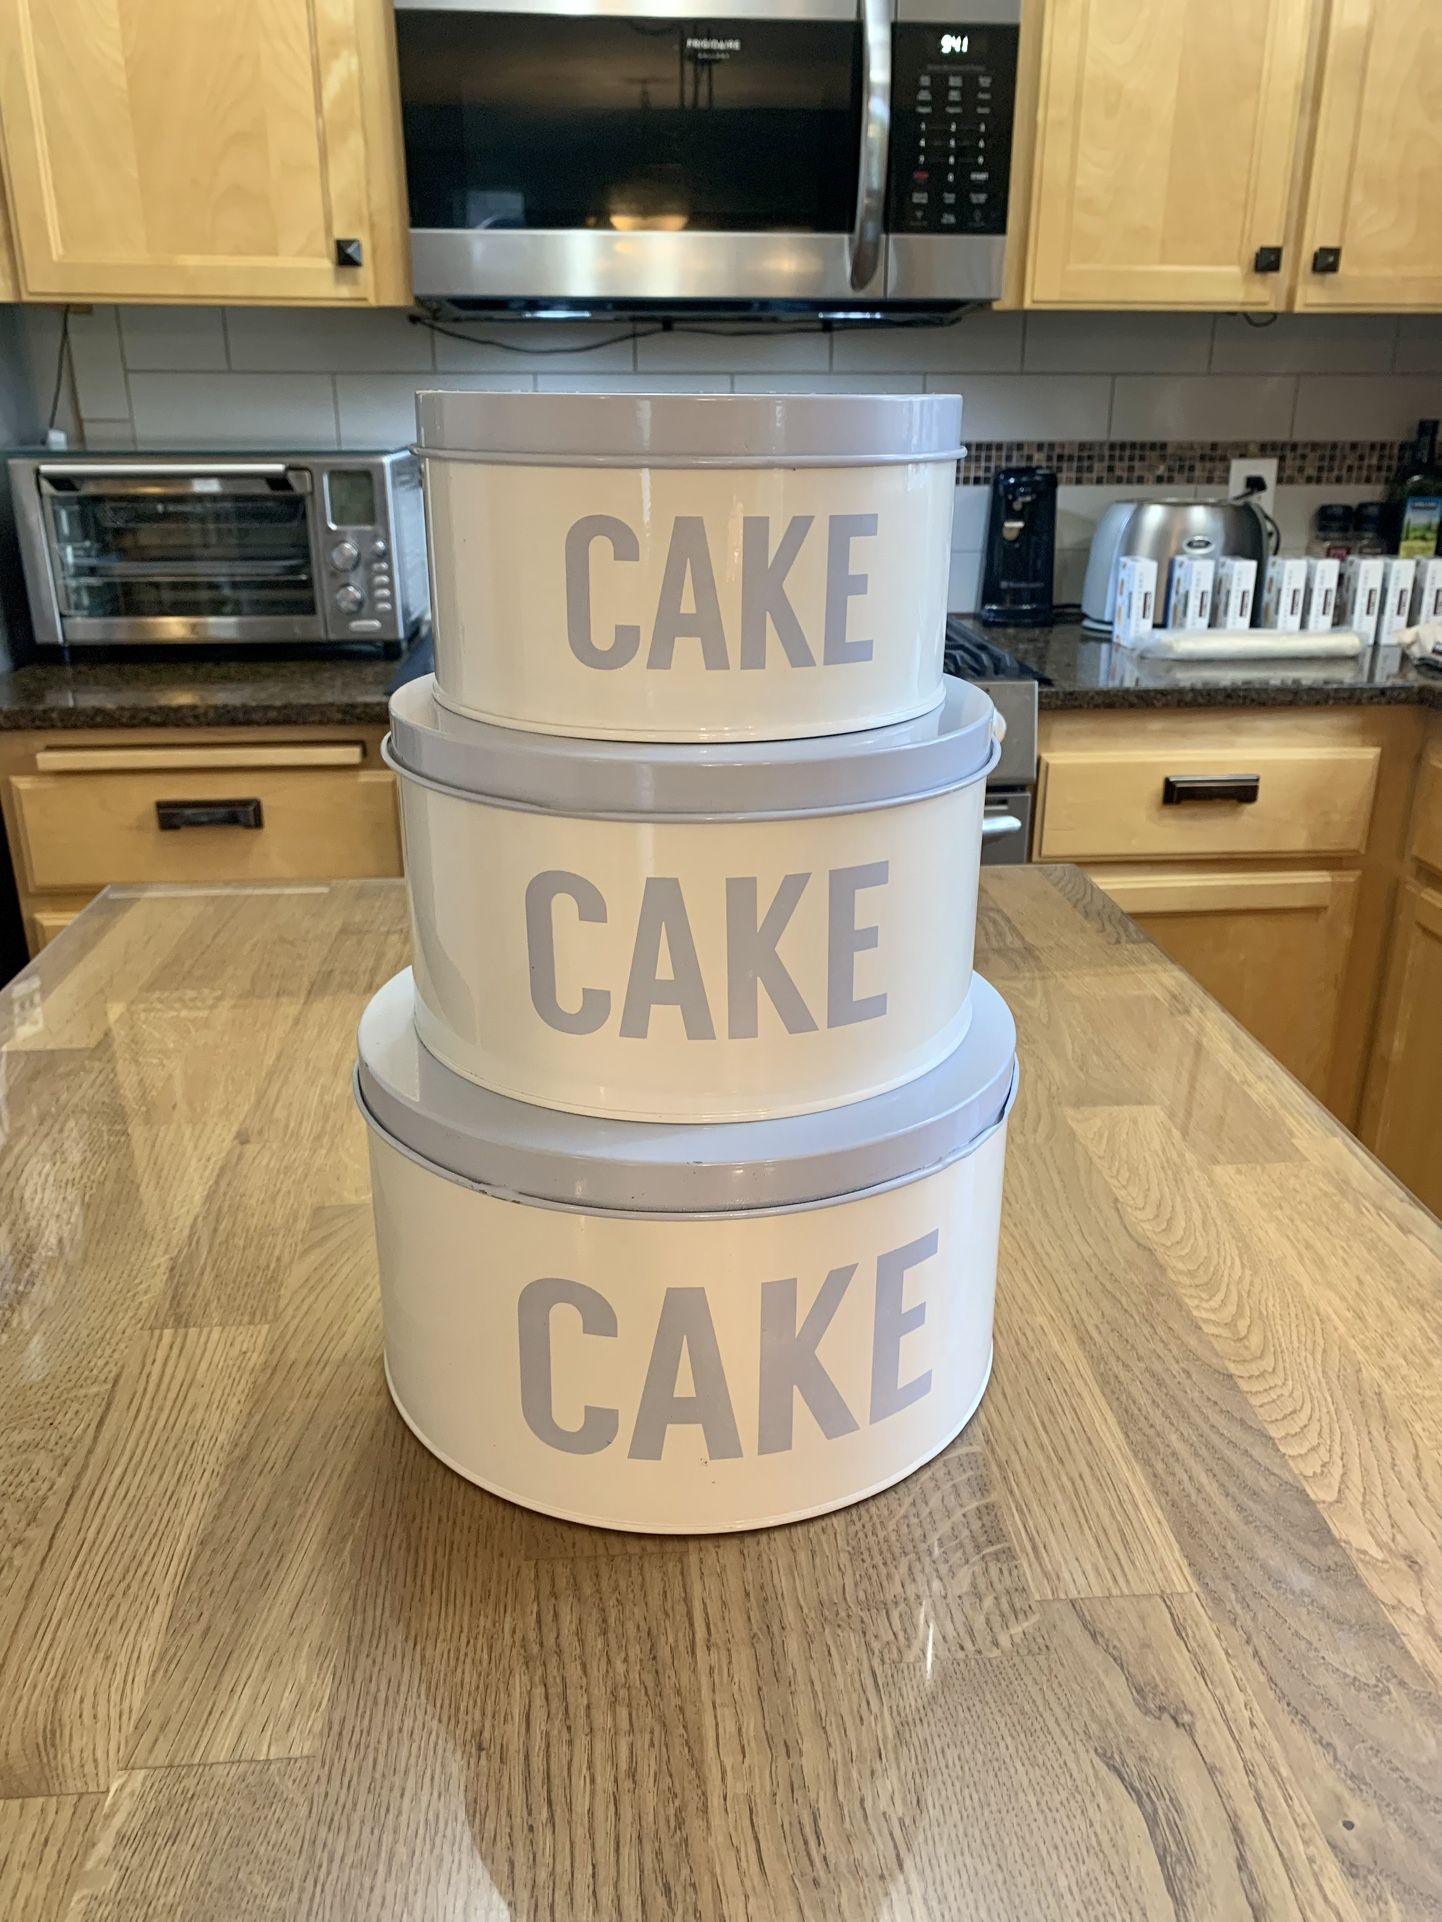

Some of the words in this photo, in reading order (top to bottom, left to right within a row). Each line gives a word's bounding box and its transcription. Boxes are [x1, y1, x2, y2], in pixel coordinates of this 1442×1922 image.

[564, 513, 879, 671] CAKE
[524, 860, 890, 1041] CAKE
[517, 1228, 939, 1461] CAKE
